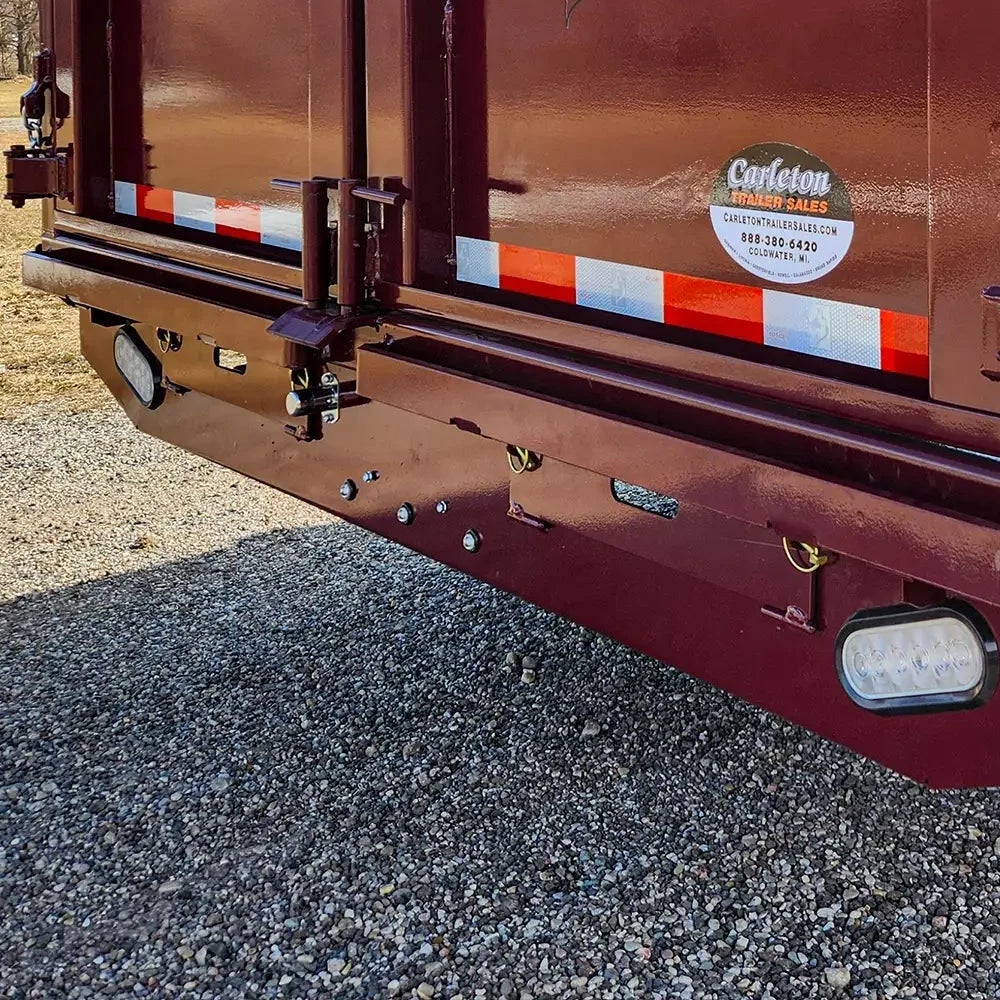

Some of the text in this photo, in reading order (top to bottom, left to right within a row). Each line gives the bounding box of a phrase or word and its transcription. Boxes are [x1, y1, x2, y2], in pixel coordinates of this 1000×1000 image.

[727, 157, 831, 197] Carleton
[731, 190, 829, 214] TRAILER SALES
[723, 213, 838, 236] CARLETONTRAILERSALES.COM
[749, 247, 797, 263] COLDWATER,
[800, 254, 810, 264] MI.
